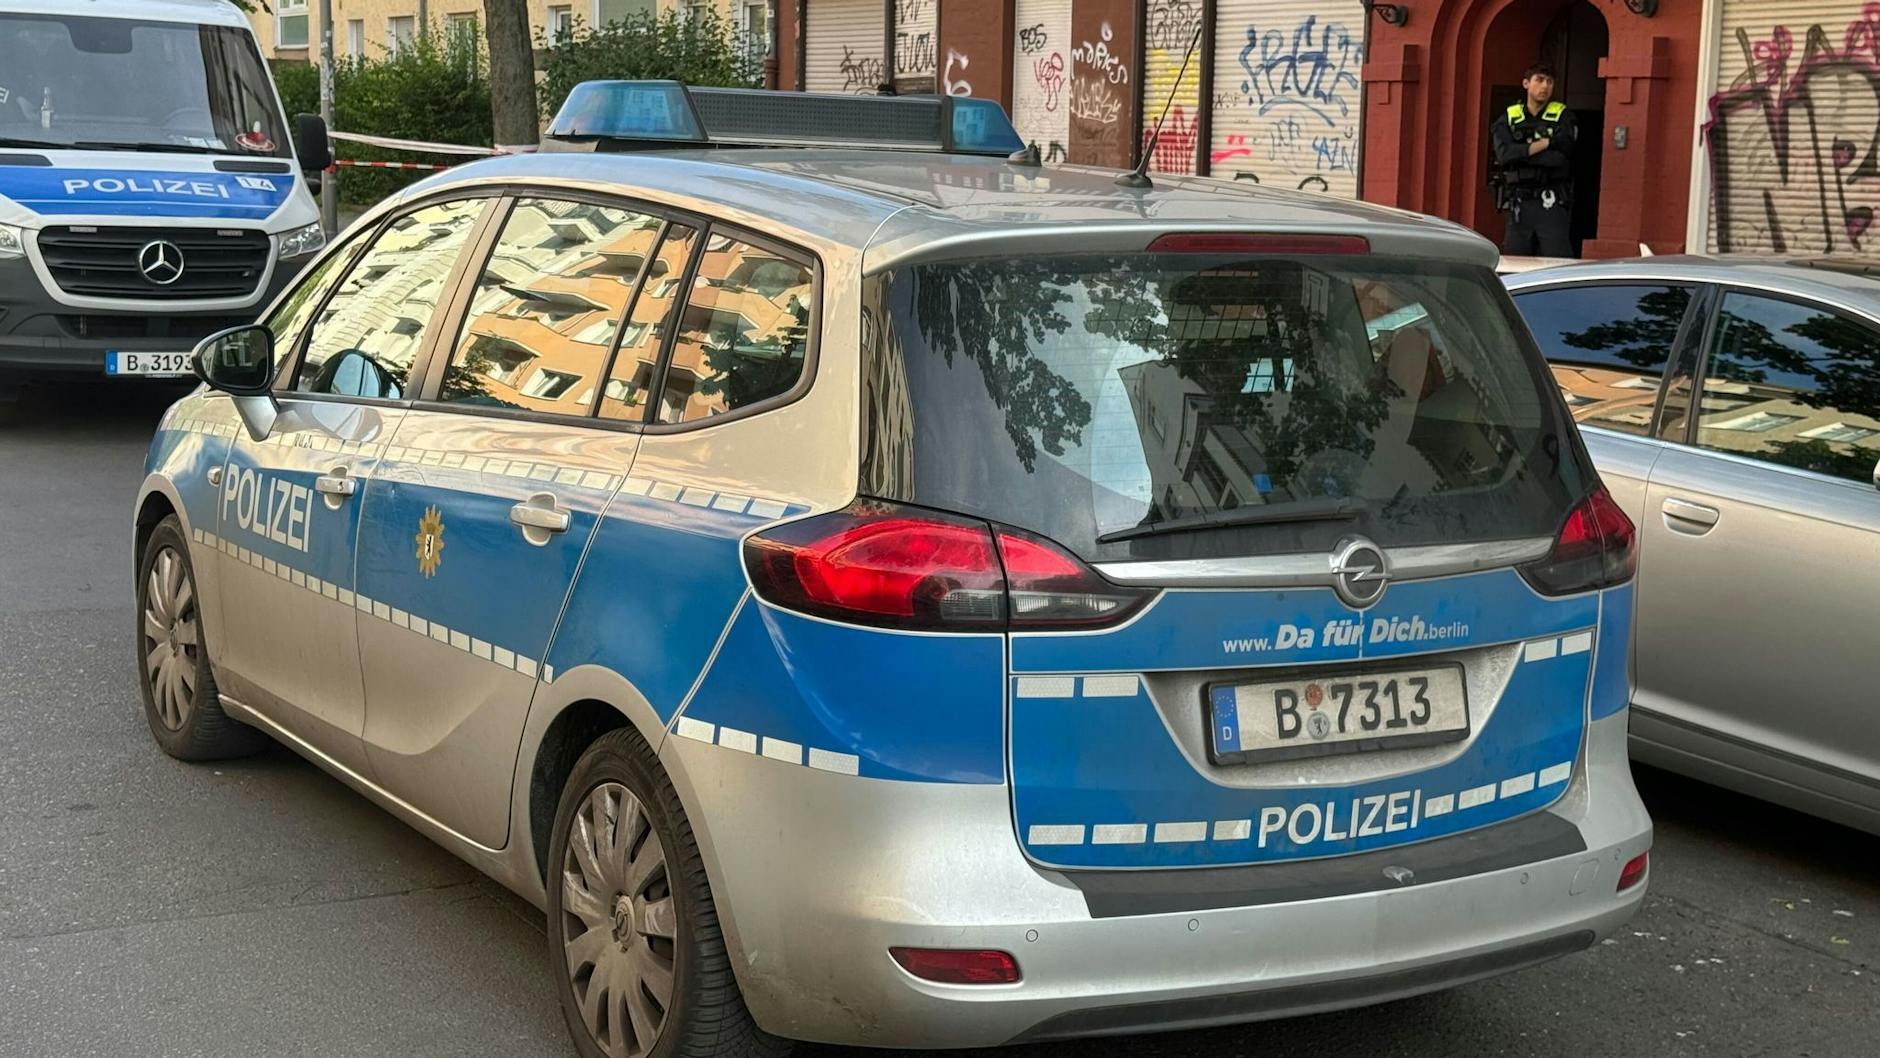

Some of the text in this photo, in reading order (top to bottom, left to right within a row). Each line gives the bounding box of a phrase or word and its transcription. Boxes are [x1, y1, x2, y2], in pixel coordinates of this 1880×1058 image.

[63, 178, 230, 199] POLIZEI
[127, 355, 138, 371] B
[223, 463, 313, 552] POLIZEI
[1322, 620, 1365, 648] für
[1272, 676, 1432, 739] B 7313
[1257, 789, 1421, 849] POLIZEI
